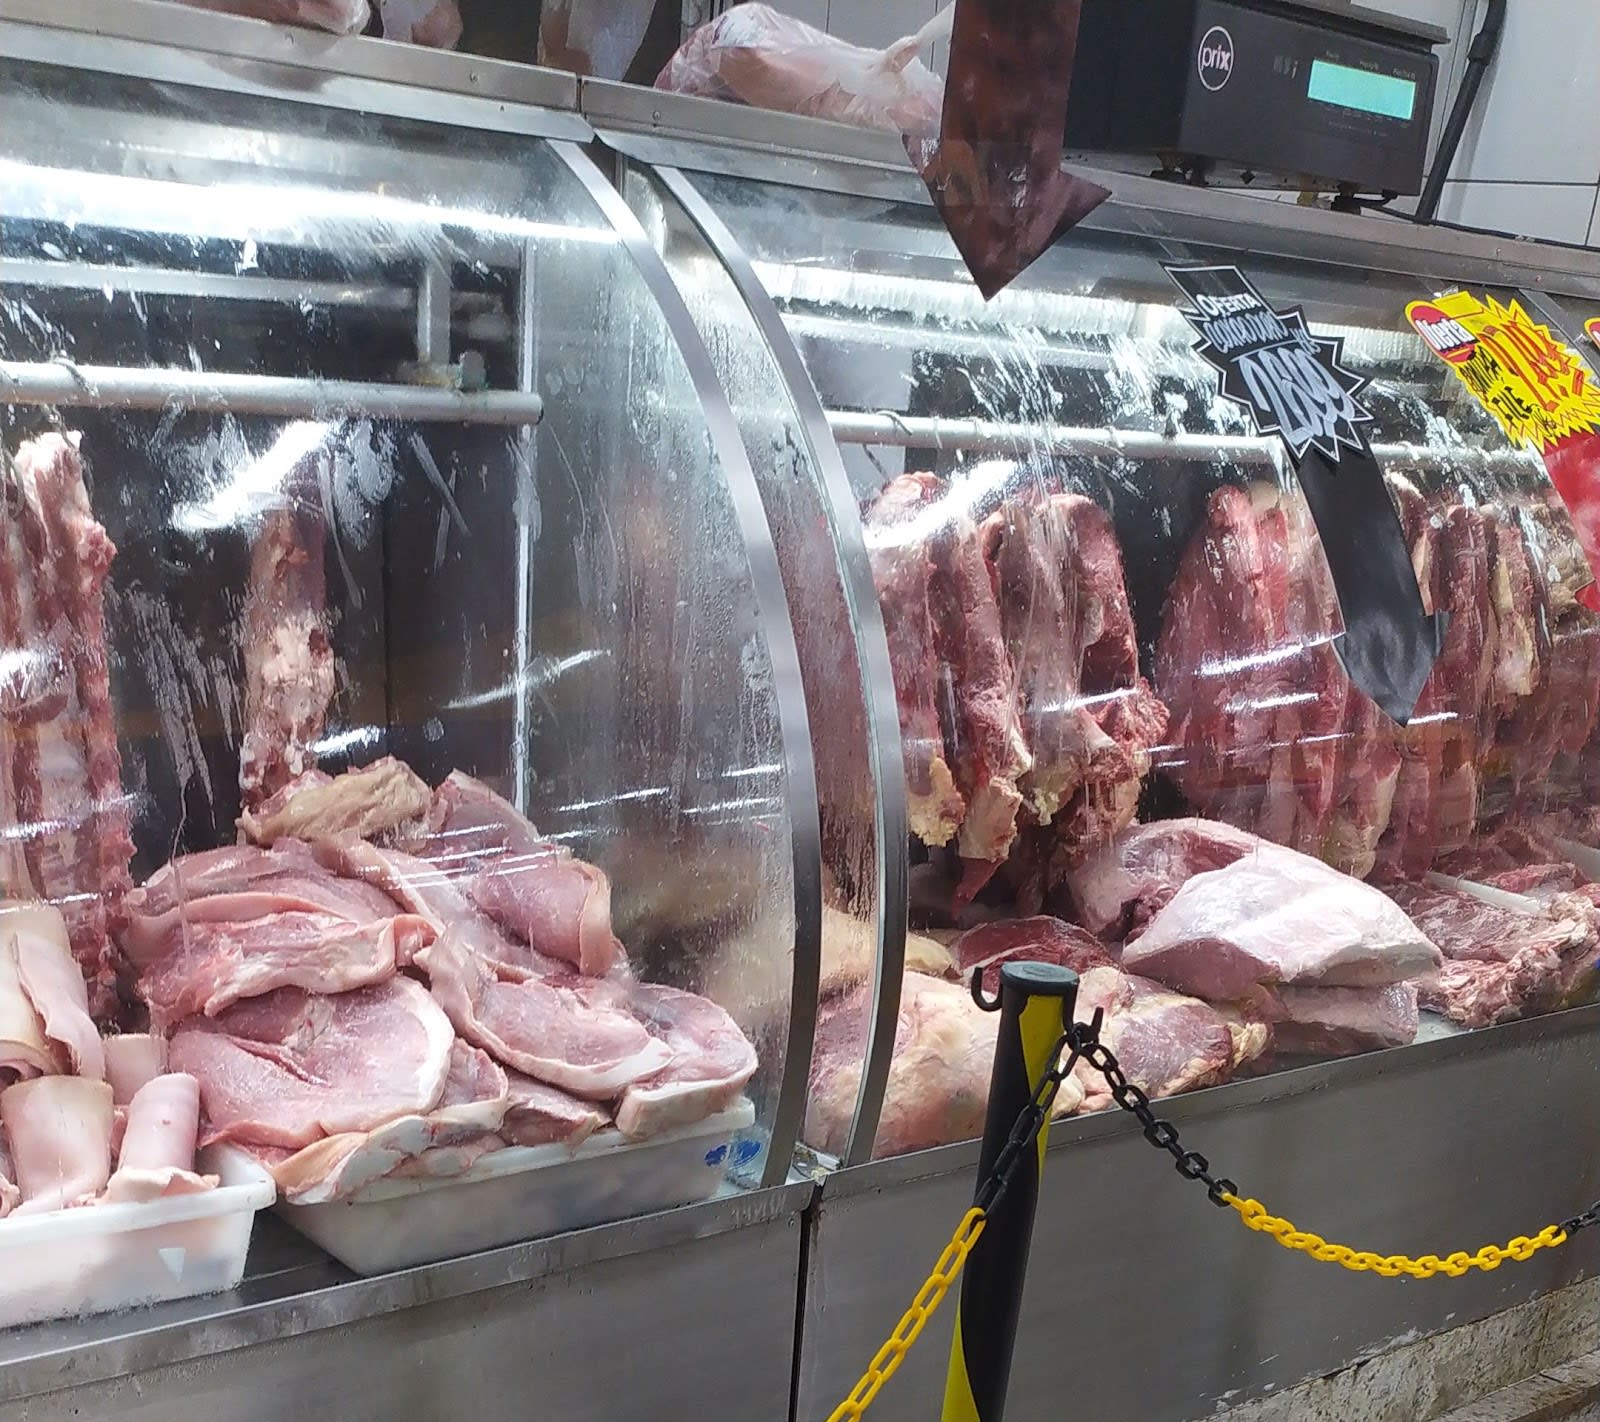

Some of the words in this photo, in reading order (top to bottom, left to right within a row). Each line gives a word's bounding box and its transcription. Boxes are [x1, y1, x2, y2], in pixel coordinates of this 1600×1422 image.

[1201, 44, 1232, 71] prix
[1196, 293, 1261, 316] OFERTA
[1415, 318, 1475, 350] Oferta
